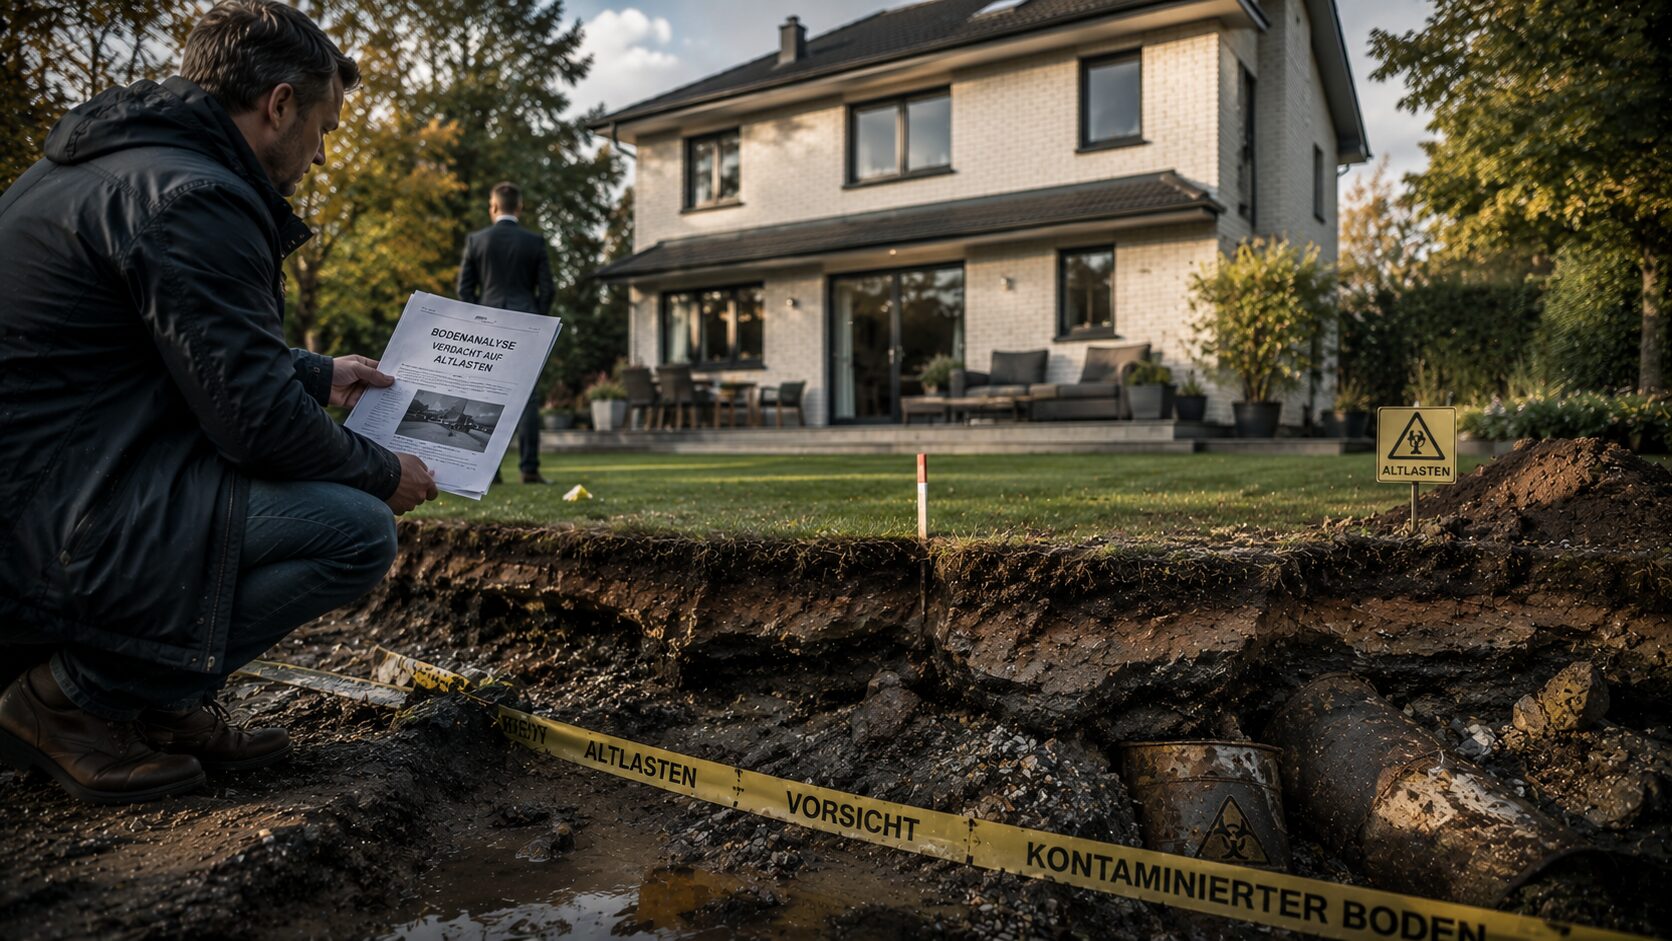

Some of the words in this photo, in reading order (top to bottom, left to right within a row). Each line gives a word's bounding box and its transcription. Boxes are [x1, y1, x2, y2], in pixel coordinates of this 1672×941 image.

[431, 328, 516, 350] BODENANALYSE
[432, 342, 482, 358] VERDACHT
[483, 352, 503, 361] AUF
[434, 355, 493, 372] ALTLASTEN
[1382, 466, 1450, 477] ALTLASTEN
[584, 740, 697, 788] ALTLASTEN
[786, 790, 920, 841] VORSICHT
[1026, 841, 1328, 924] KONTAMINIERTER
[1343, 900, 1486, 941] BODEN
